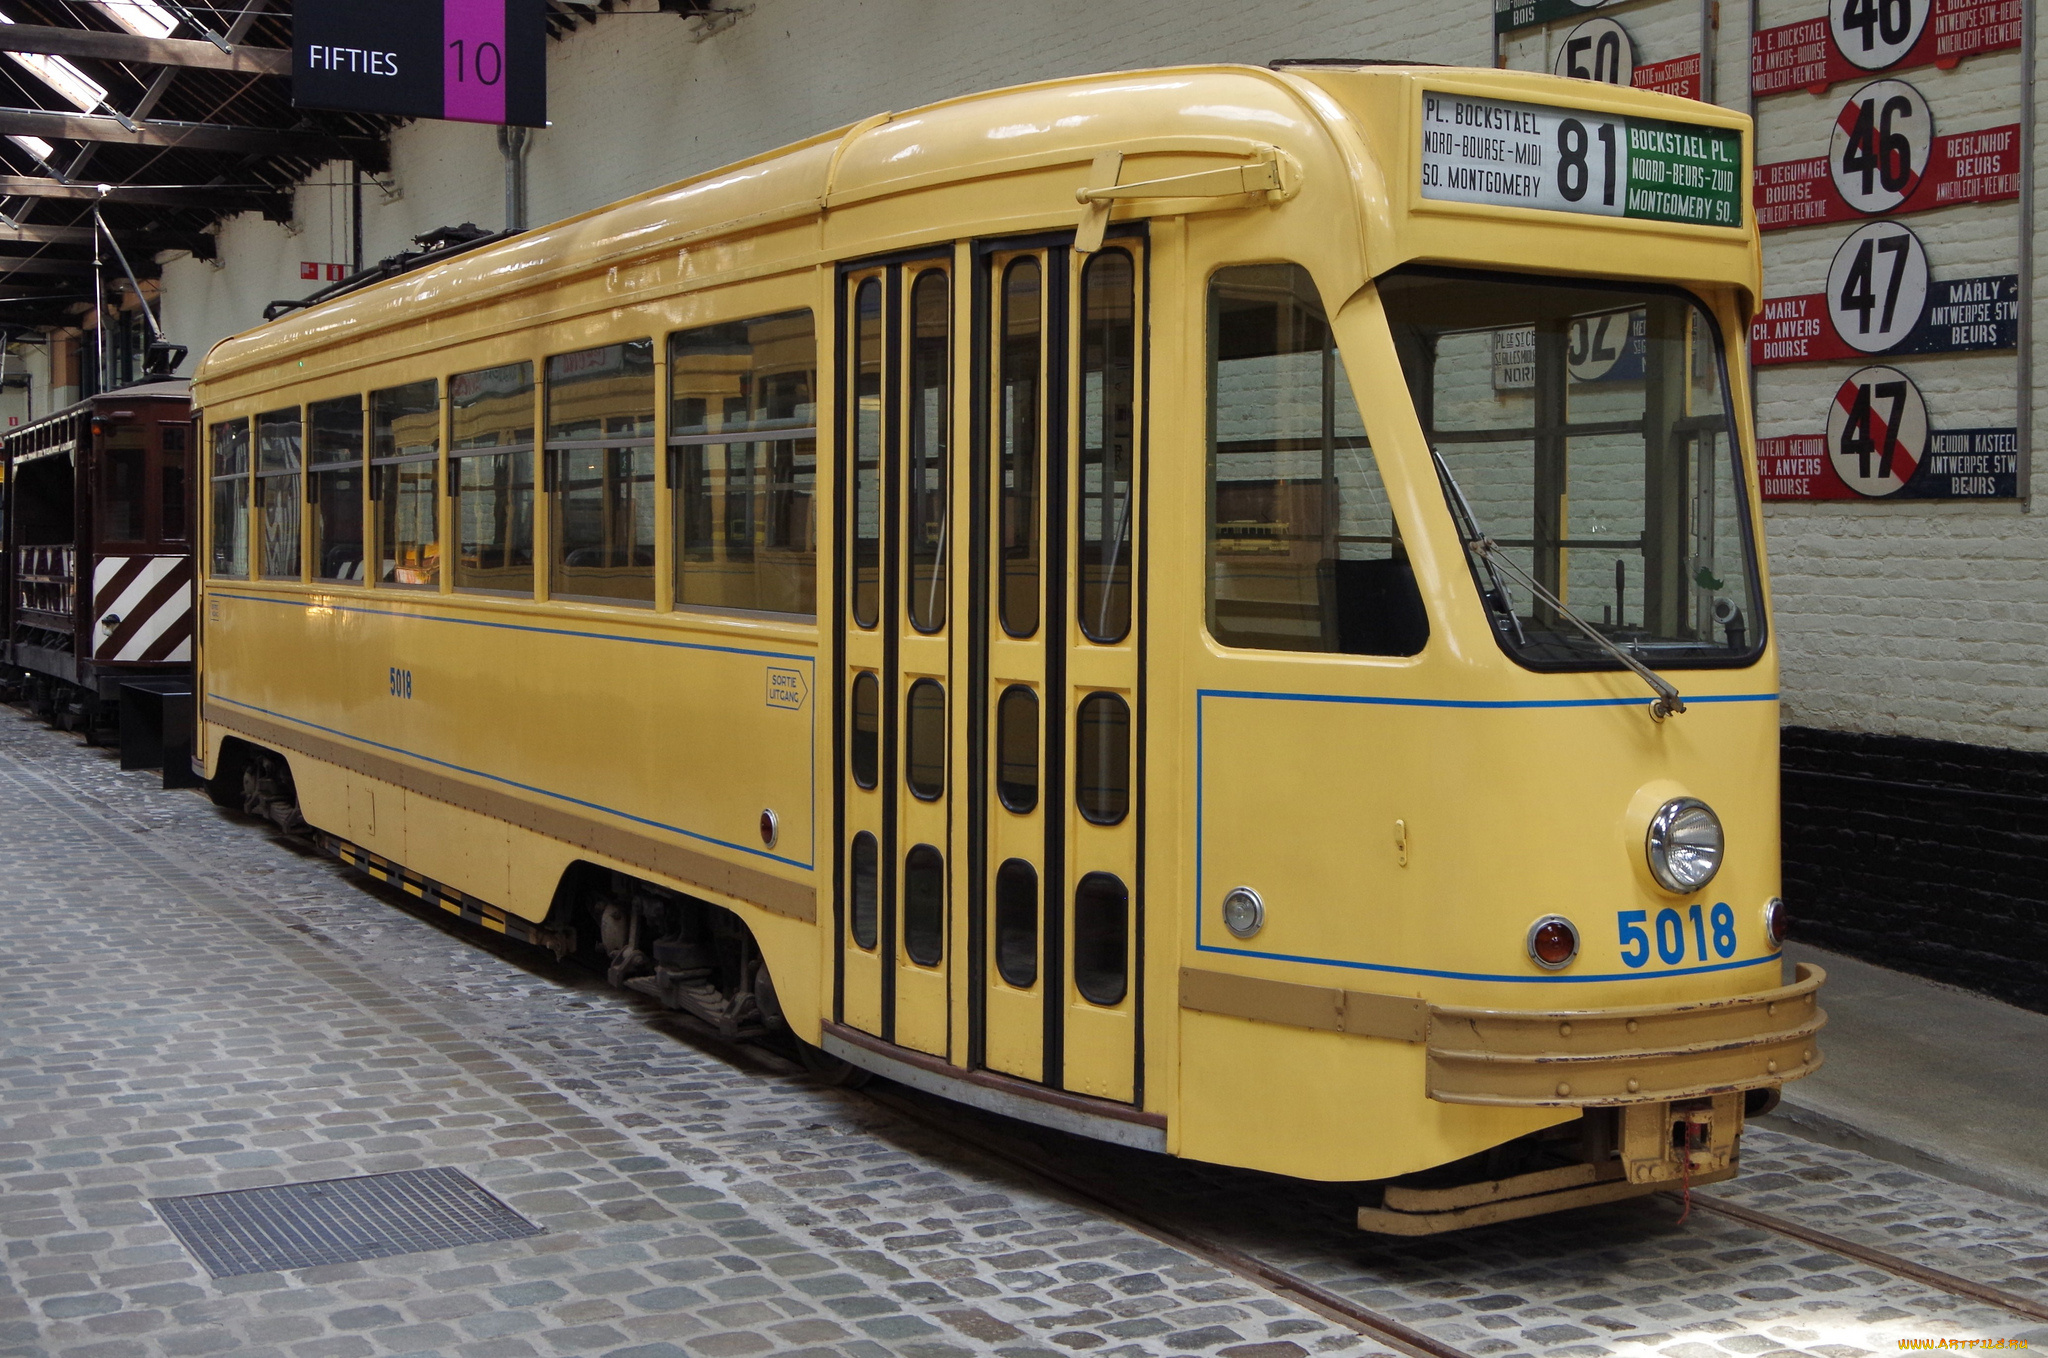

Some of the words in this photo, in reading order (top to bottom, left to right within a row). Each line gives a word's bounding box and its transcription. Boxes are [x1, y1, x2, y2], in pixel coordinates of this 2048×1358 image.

[1513, 6, 1535, 26] BOIS
[1935, 9, 1978, 35] ANTWERPSE
[1768, 34, 1775, 50] E.
[1778, 22, 1826, 48] BOCKSTAEL
[310, 44, 398, 76] FIFTIES
[450, 39, 502, 86] 10
[1566, 30, 1620, 84] 50
[1426, 99, 1449, 123] PL.
[1455, 103, 1541, 135] BOCKSTAEL
[1630, 128, 1707, 160] BOCKSTAEL
[1711, 141, 1733, 163] PL.
[1843, 96, 1912, 195] 46
[1947, 131, 2012, 158] BEGIJNHOF
[1557, 117, 1616, 206] 81
[1771, 160, 1828, 184] BEGUINAGE
[1956, 155, 2001, 178] BEURS
[1423, 163, 1443, 188] SQ.
[1448, 167, 1541, 198] MONTGOMERY
[1766, 182, 1812, 204] BOURSE
[1629, 188, 1712, 221] MONTGOMERY
[1715, 200, 1733, 223] SQ.
[1841, 234, 1910, 334] 47
[1950, 281, 2000, 303] MARLY
[1765, 300, 1807, 320] MARLY
[1931, 303, 1991, 326] ANTWERPSE
[1753, 324, 1771, 341] CH.
[1775, 319, 1820, 339] ANVERS
[1952, 324, 1997, 345] BEURS
[1764, 339, 1808, 359] BOURSE
[1841, 380, 1907, 479] 47
[1756, 440, 1785, 457] HATEAU
[1790, 438, 1823, 456] MEUDON
[1931, 434, 1970, 453] MEUDON
[1975, 433, 2017, 452] KASTEEL
[1757, 459, 1771, 476] H.
[1776, 458, 1821, 476] ANVERS
[1930, 455, 1989, 474] ANTWERPSE
[1765, 478, 1810, 495] BOURSE
[1951, 476, 1995, 495] BEURS
[390, 667, 412, 699] 5018
[772, 674, 797, 688] SORTIE
[769, 688, 799, 703] UITGANG
[1617, 902, 1736, 968] 5018
